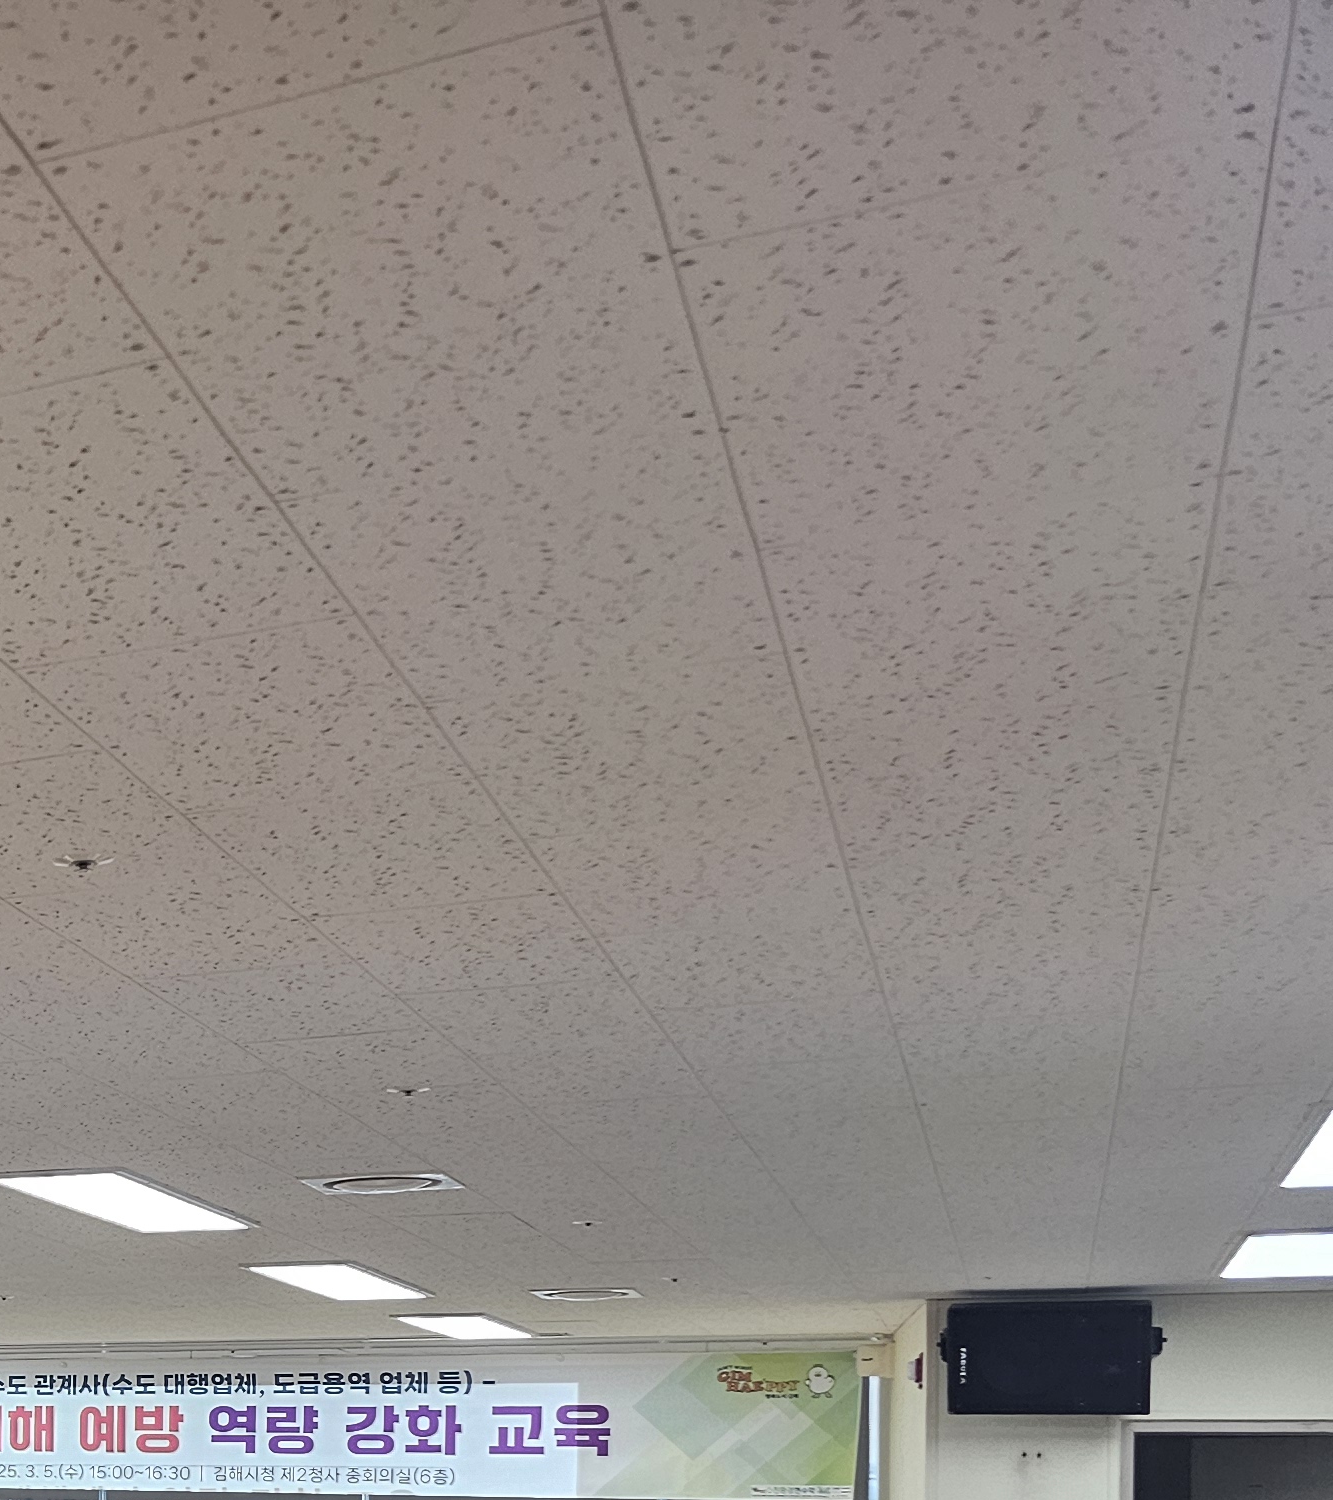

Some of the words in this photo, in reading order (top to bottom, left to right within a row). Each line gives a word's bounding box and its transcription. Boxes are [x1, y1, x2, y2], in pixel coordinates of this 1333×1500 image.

[34, 1373, 156, 1397] 관계사(수도
[163, 1372, 265, 1398] 대행업체,
[273, 1371, 372, 1395] 도급용역
[379, 1371, 429, 1395] 업체
[437, 1369, 474, 1395] 등)
[79, 1405, 184, 1454] 예방
[208, 1405, 319, 1455] 역량
[345, 1404, 462, 1456] 강화
[488, 1404, 613, 1457] 교육
[25, 1464, 39, 1479] 3.
[90, 1464, 191, 1481] 15:00~16:30
[213, 1466, 275, 1482] 김해시청
[280, 1467, 340, 1484] 제2청사
[345, 1467, 456, 1486] 중회의실(6층)
